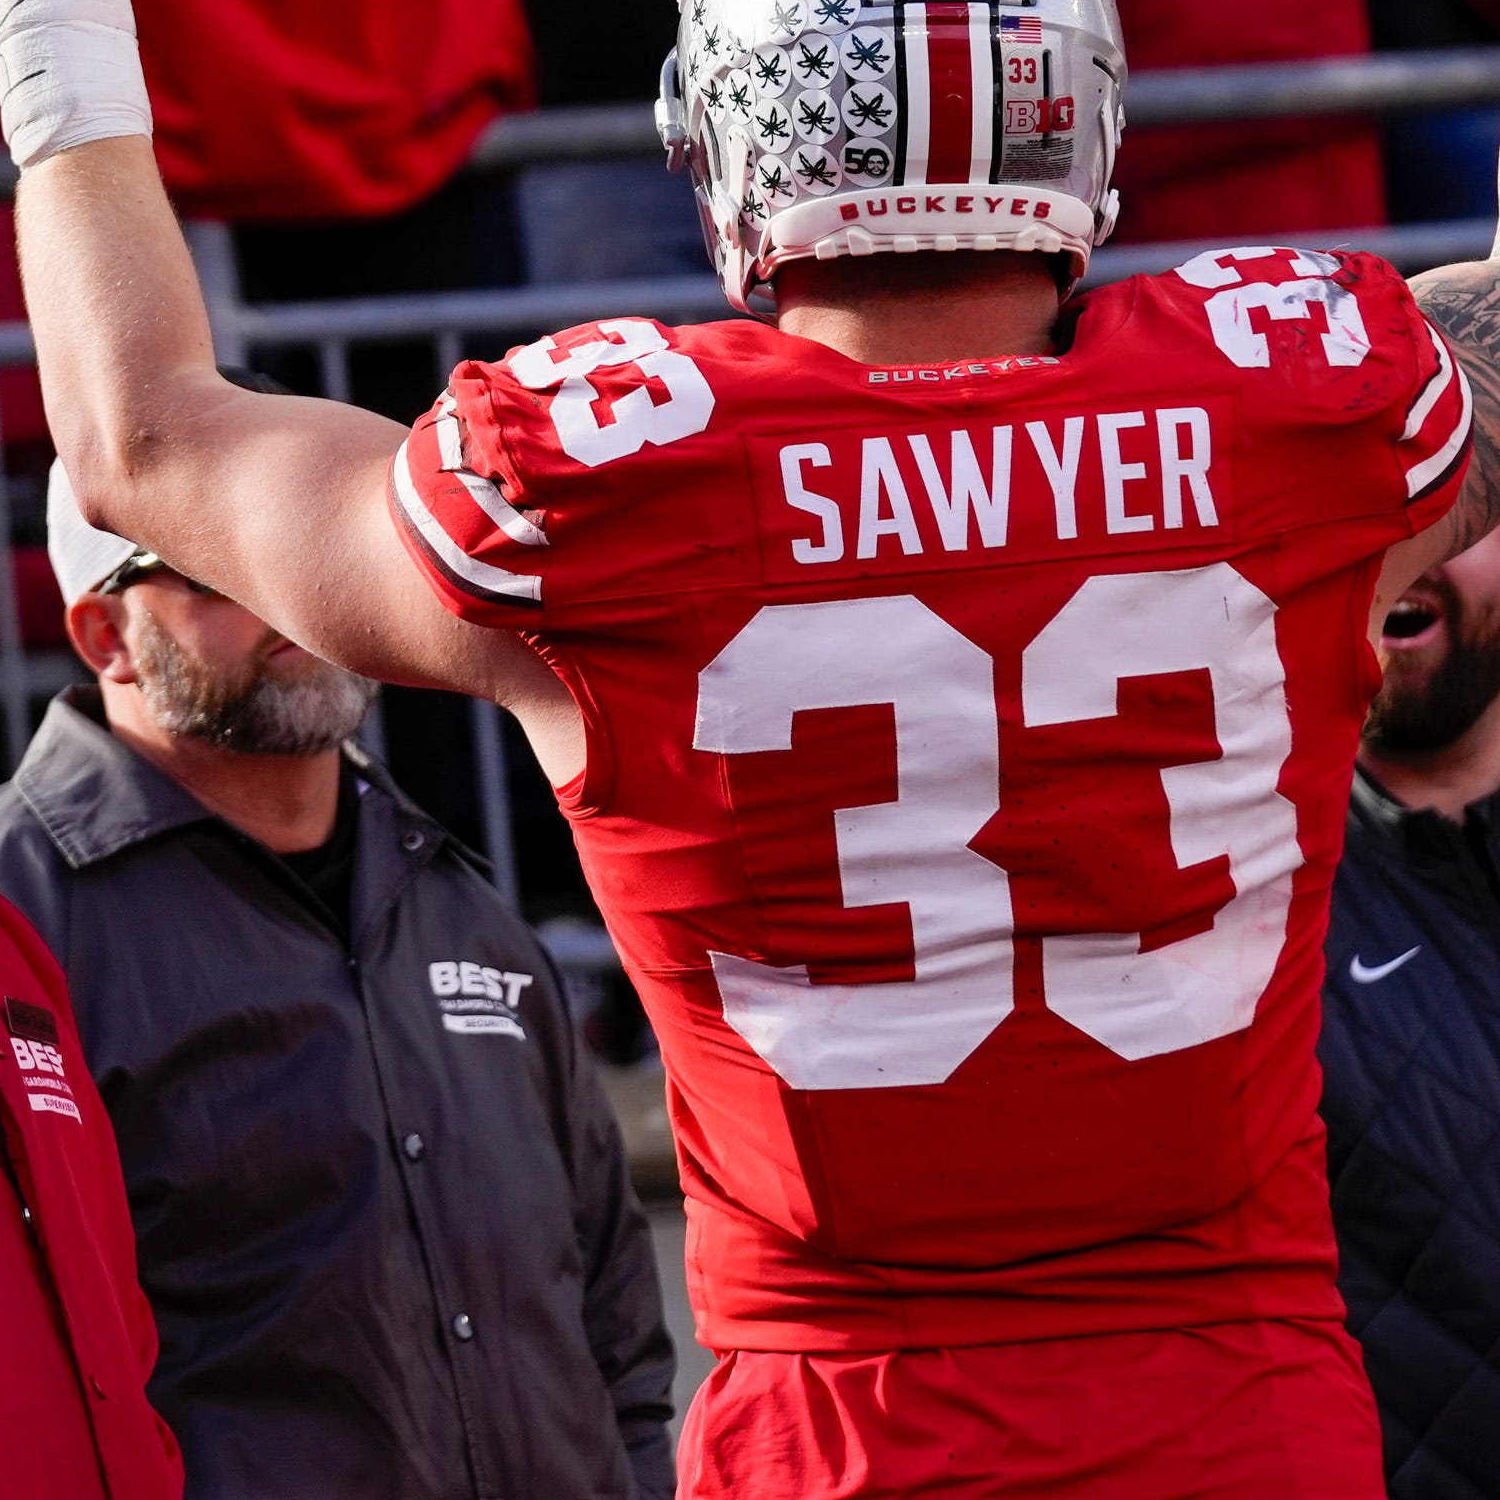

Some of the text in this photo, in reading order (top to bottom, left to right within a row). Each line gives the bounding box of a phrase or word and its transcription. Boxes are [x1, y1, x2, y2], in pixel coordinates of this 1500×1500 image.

[1008, 57, 1037, 84] 33
[839, 196, 1051, 221] BUCKEYES
[1173, 246, 1372, 369] 33
[507, 318, 716, 468] 33
[868, 356, 1060, 384] BUCKEYES
[779, 406, 1216, 565] SAWYER
[693, 562, 1305, 1090] 33
[429, 961, 533, 1008] BEST
[10, 1037, 65, 1077] BES
